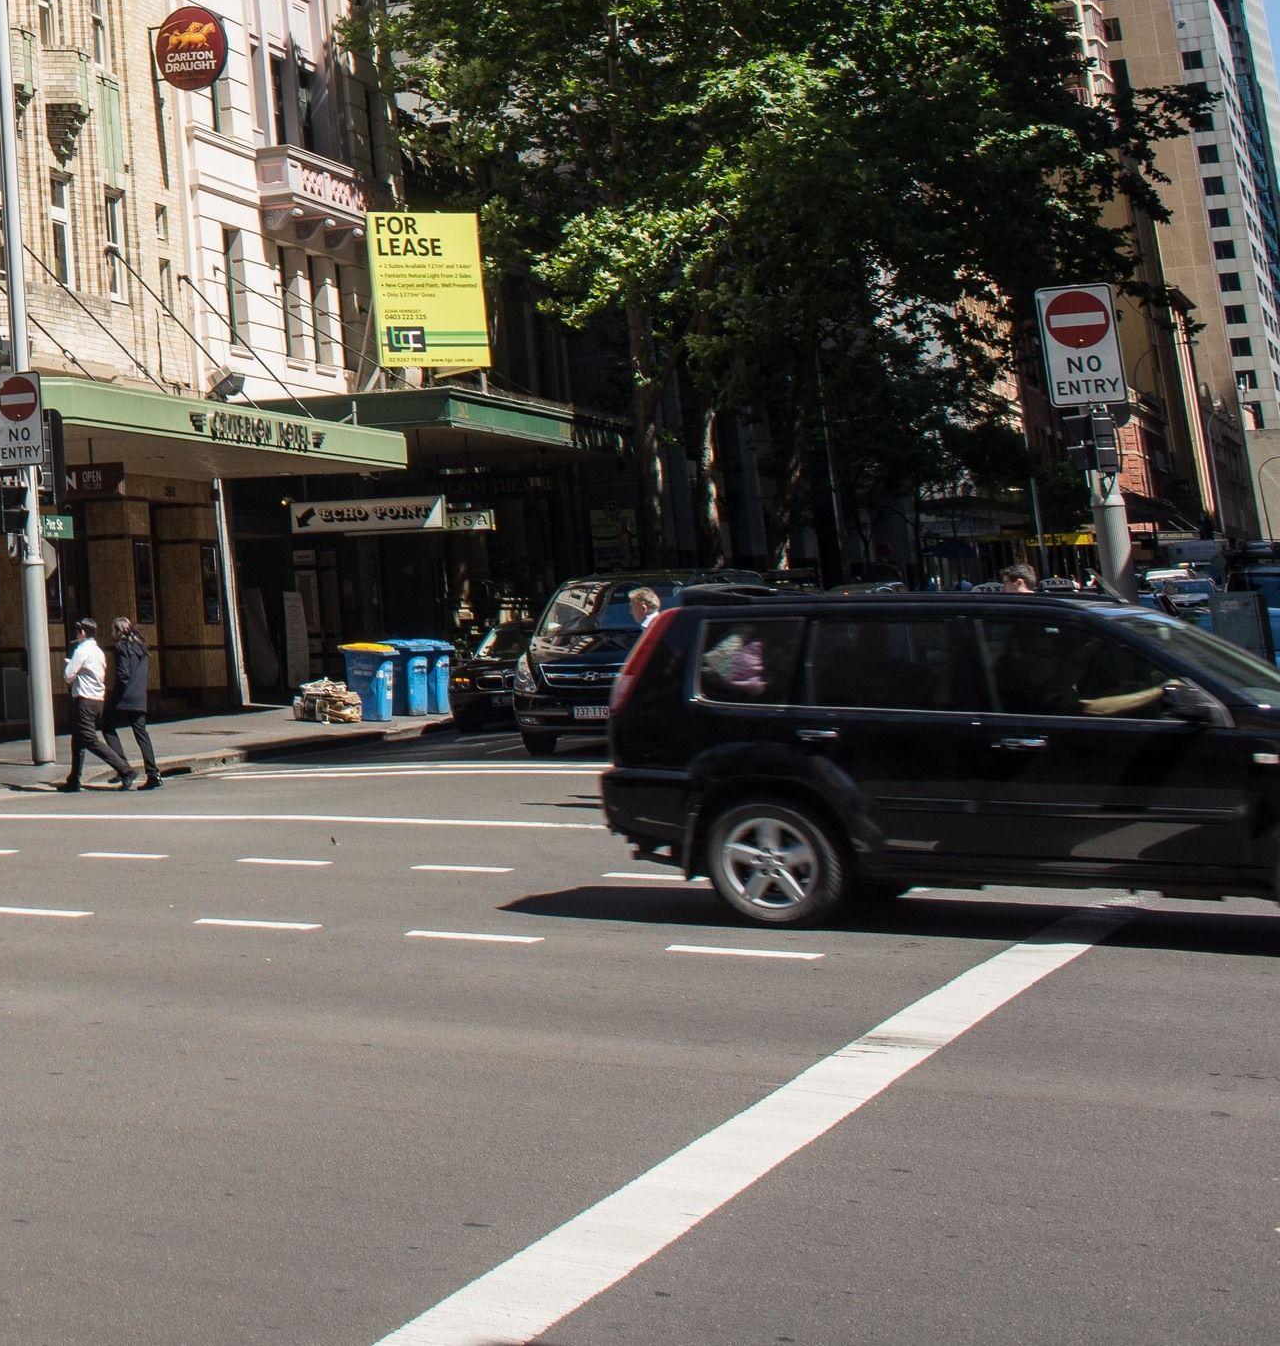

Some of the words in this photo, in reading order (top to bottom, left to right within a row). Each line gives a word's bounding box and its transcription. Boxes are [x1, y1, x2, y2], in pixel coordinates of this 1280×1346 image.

[166, 50, 214, 63] CARLTON
[165, 60, 217, 73] DRAUGHT
[375, 216, 418, 235] FOR
[376, 238, 443, 257] LEASE
[1066, 355, 1102, 374] NO
[1056, 377, 1120, 396] ENTRY
[8, 426, 31, 442] NO
[1, 444, 41, 460] ENTRY
[81, 470, 102, 483] OPEN
[319, 506, 369, 523] ECHO
[374, 504, 430, 520] POINT
[1045, 579, 1069, 587] TAXI
